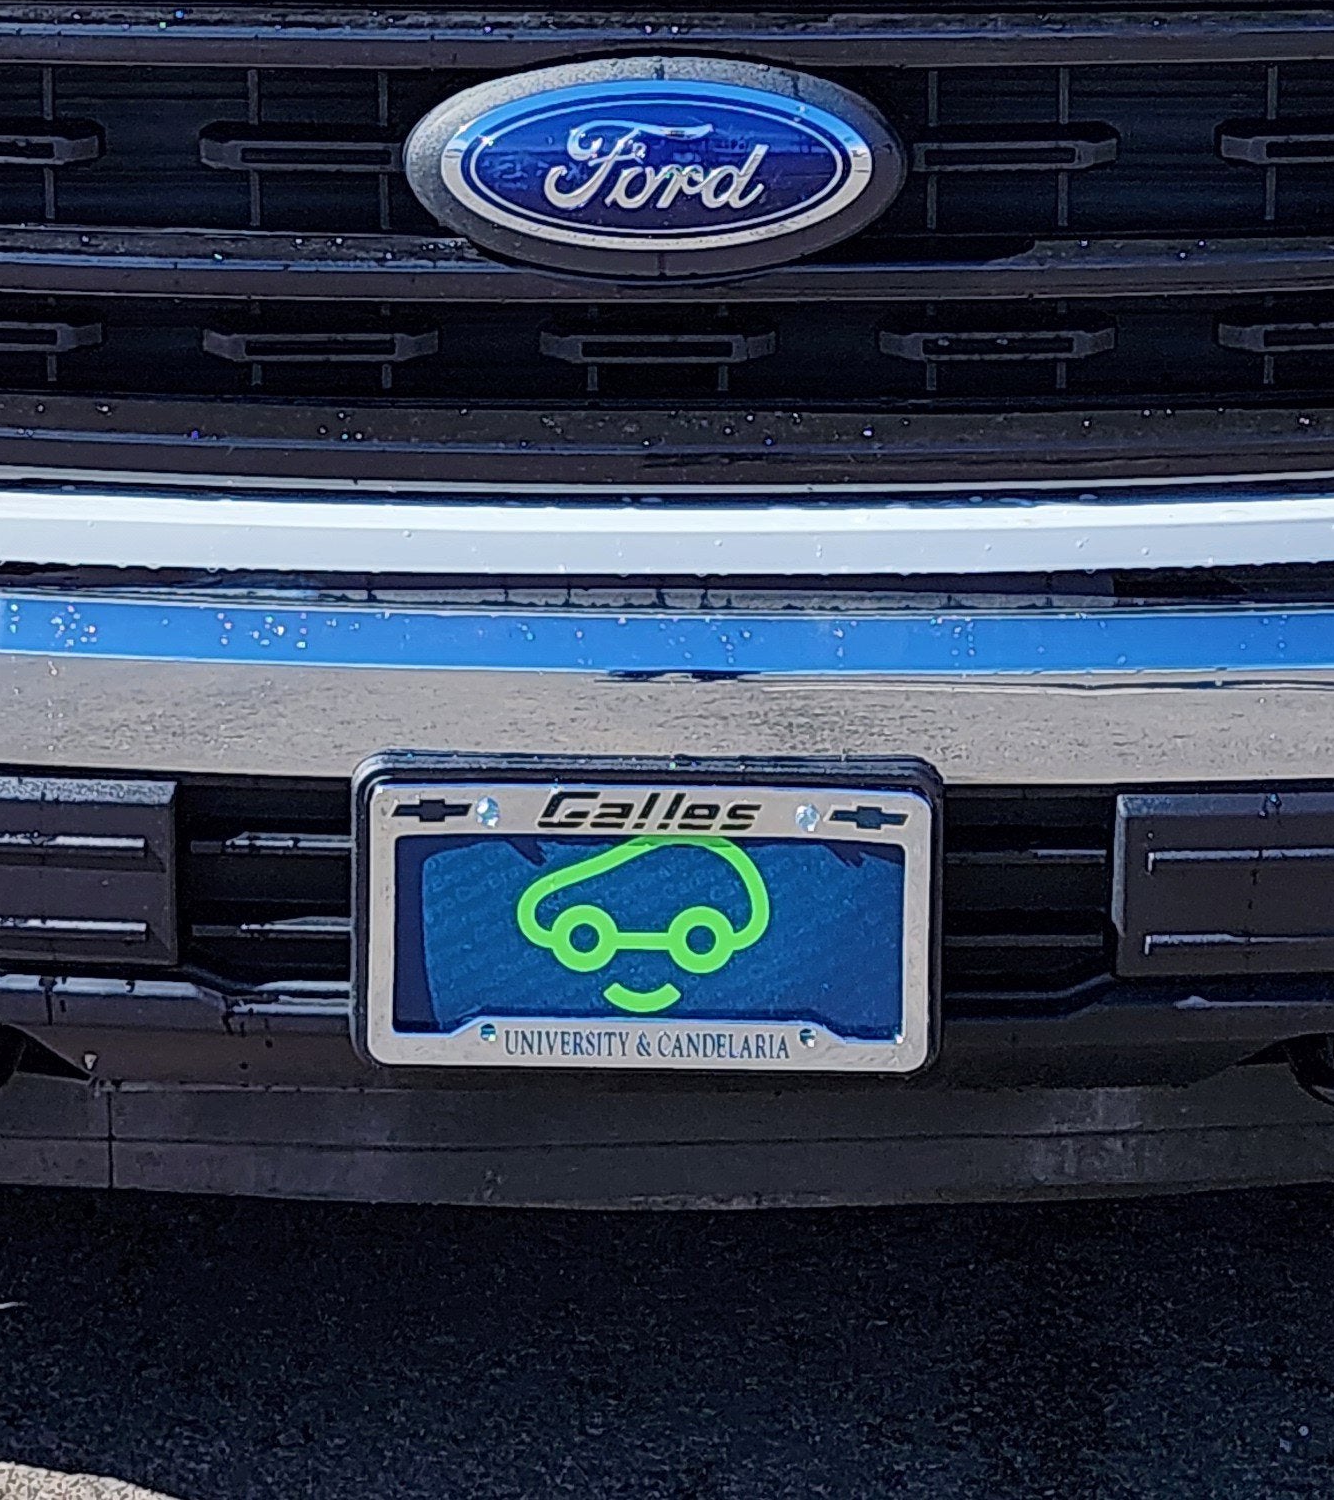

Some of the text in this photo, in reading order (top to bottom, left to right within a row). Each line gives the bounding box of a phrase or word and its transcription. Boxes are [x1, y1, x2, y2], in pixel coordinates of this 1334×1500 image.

[544, 119, 770, 209] Ford
[537, 791, 762, 831] Galles
[504, 1029, 791, 1059] UNIVERSITY & CANDELARIA
